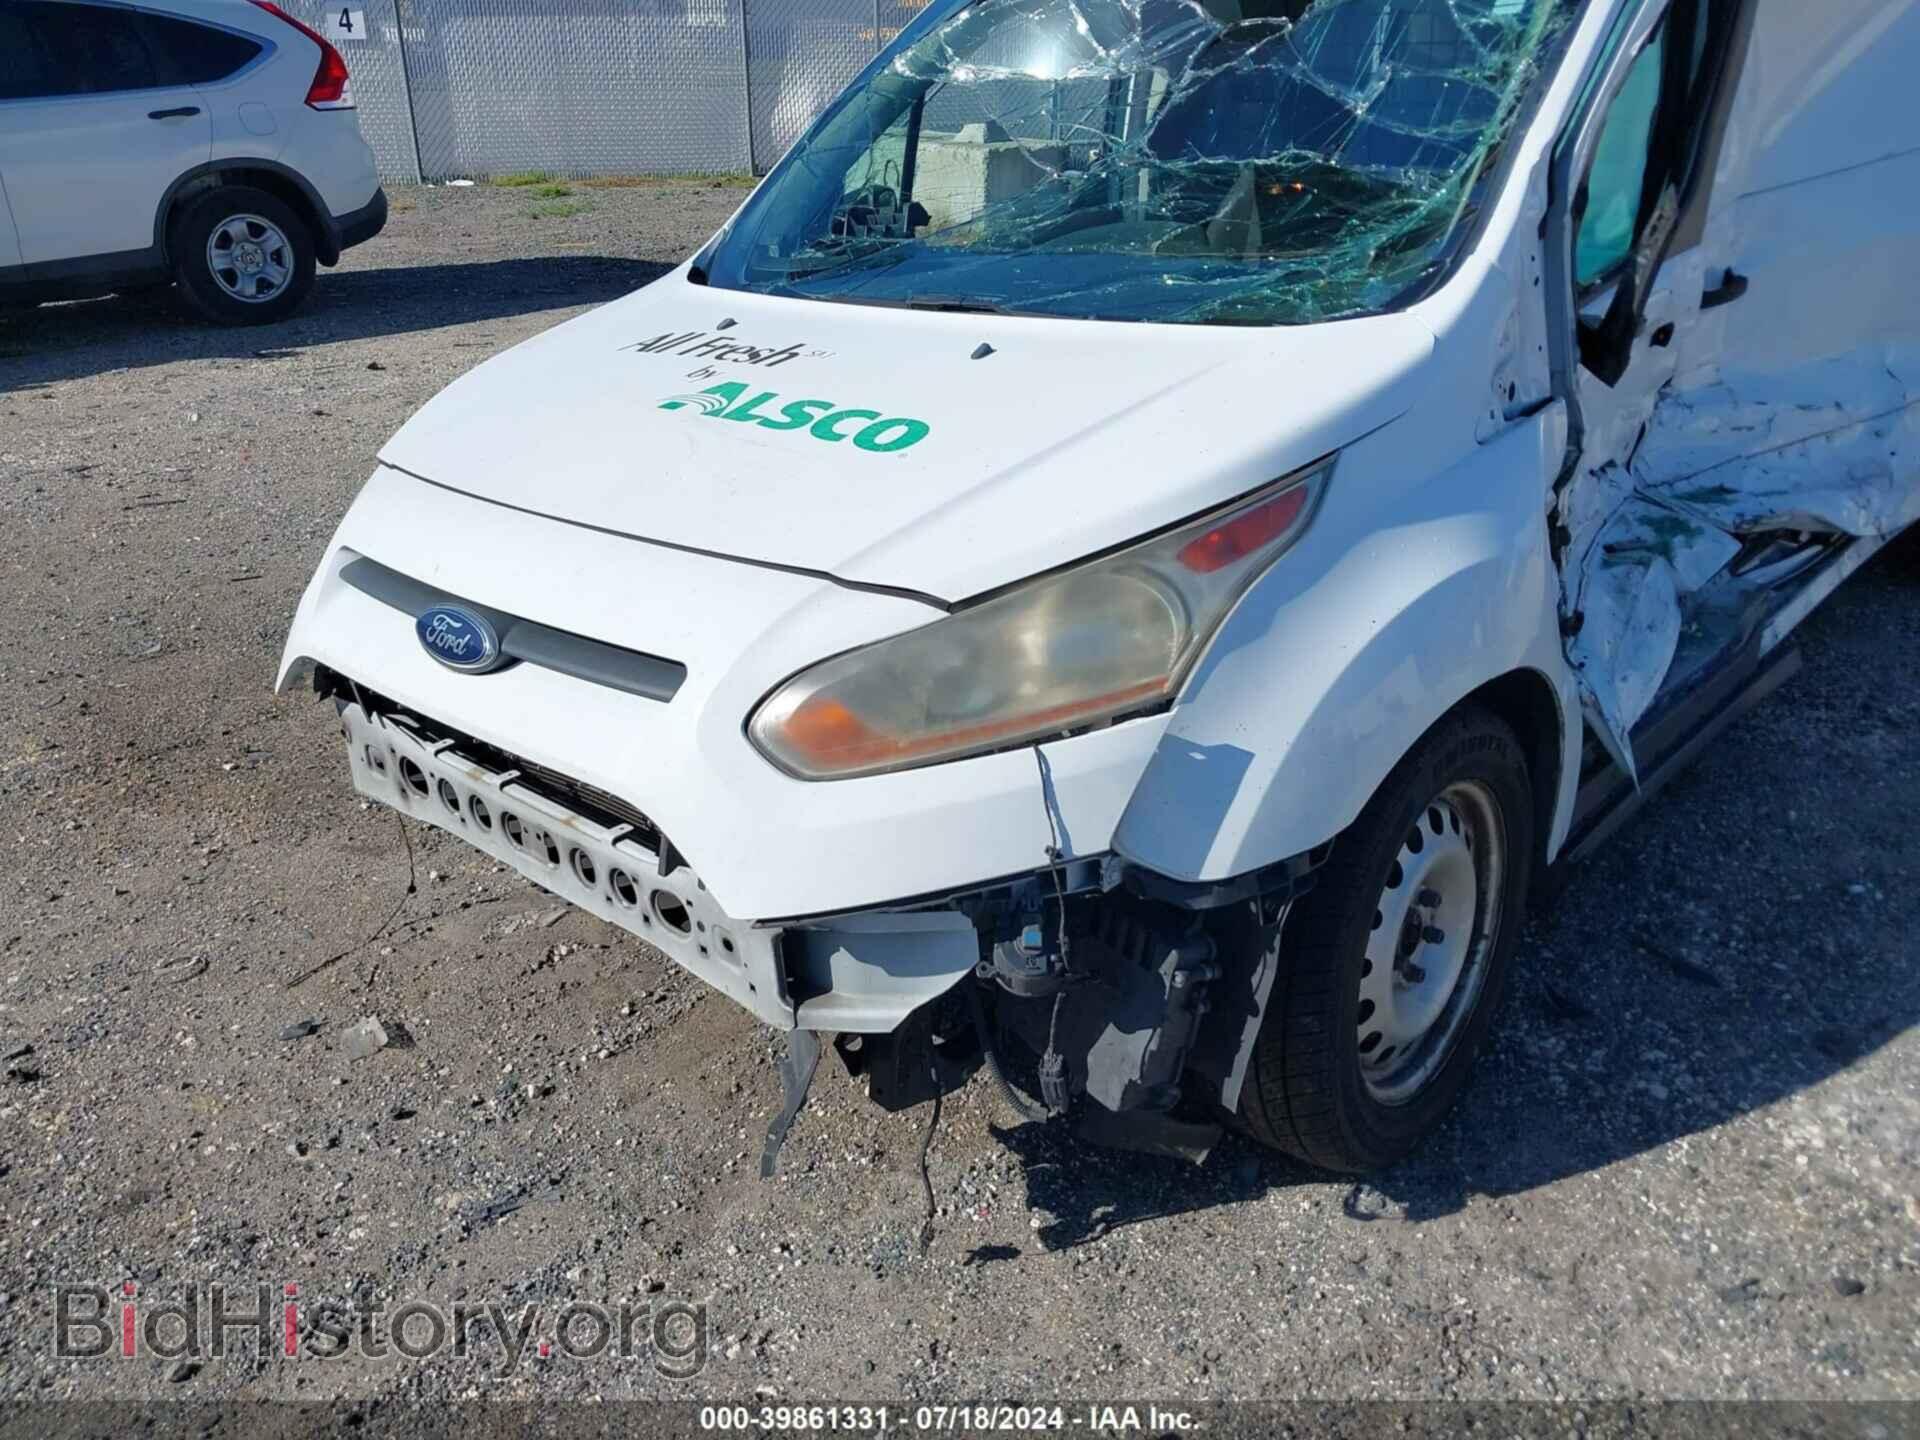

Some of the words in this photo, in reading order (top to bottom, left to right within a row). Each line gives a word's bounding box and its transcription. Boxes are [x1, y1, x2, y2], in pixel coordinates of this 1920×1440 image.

[338, 7, 354, 33] 4
[616, 331, 707, 354] All
[677, 336, 807, 367] Fresh
[685, 364, 725, 383] by
[657, 381, 930, 452] ALSCO
[426, 614, 472, 655] Ford
